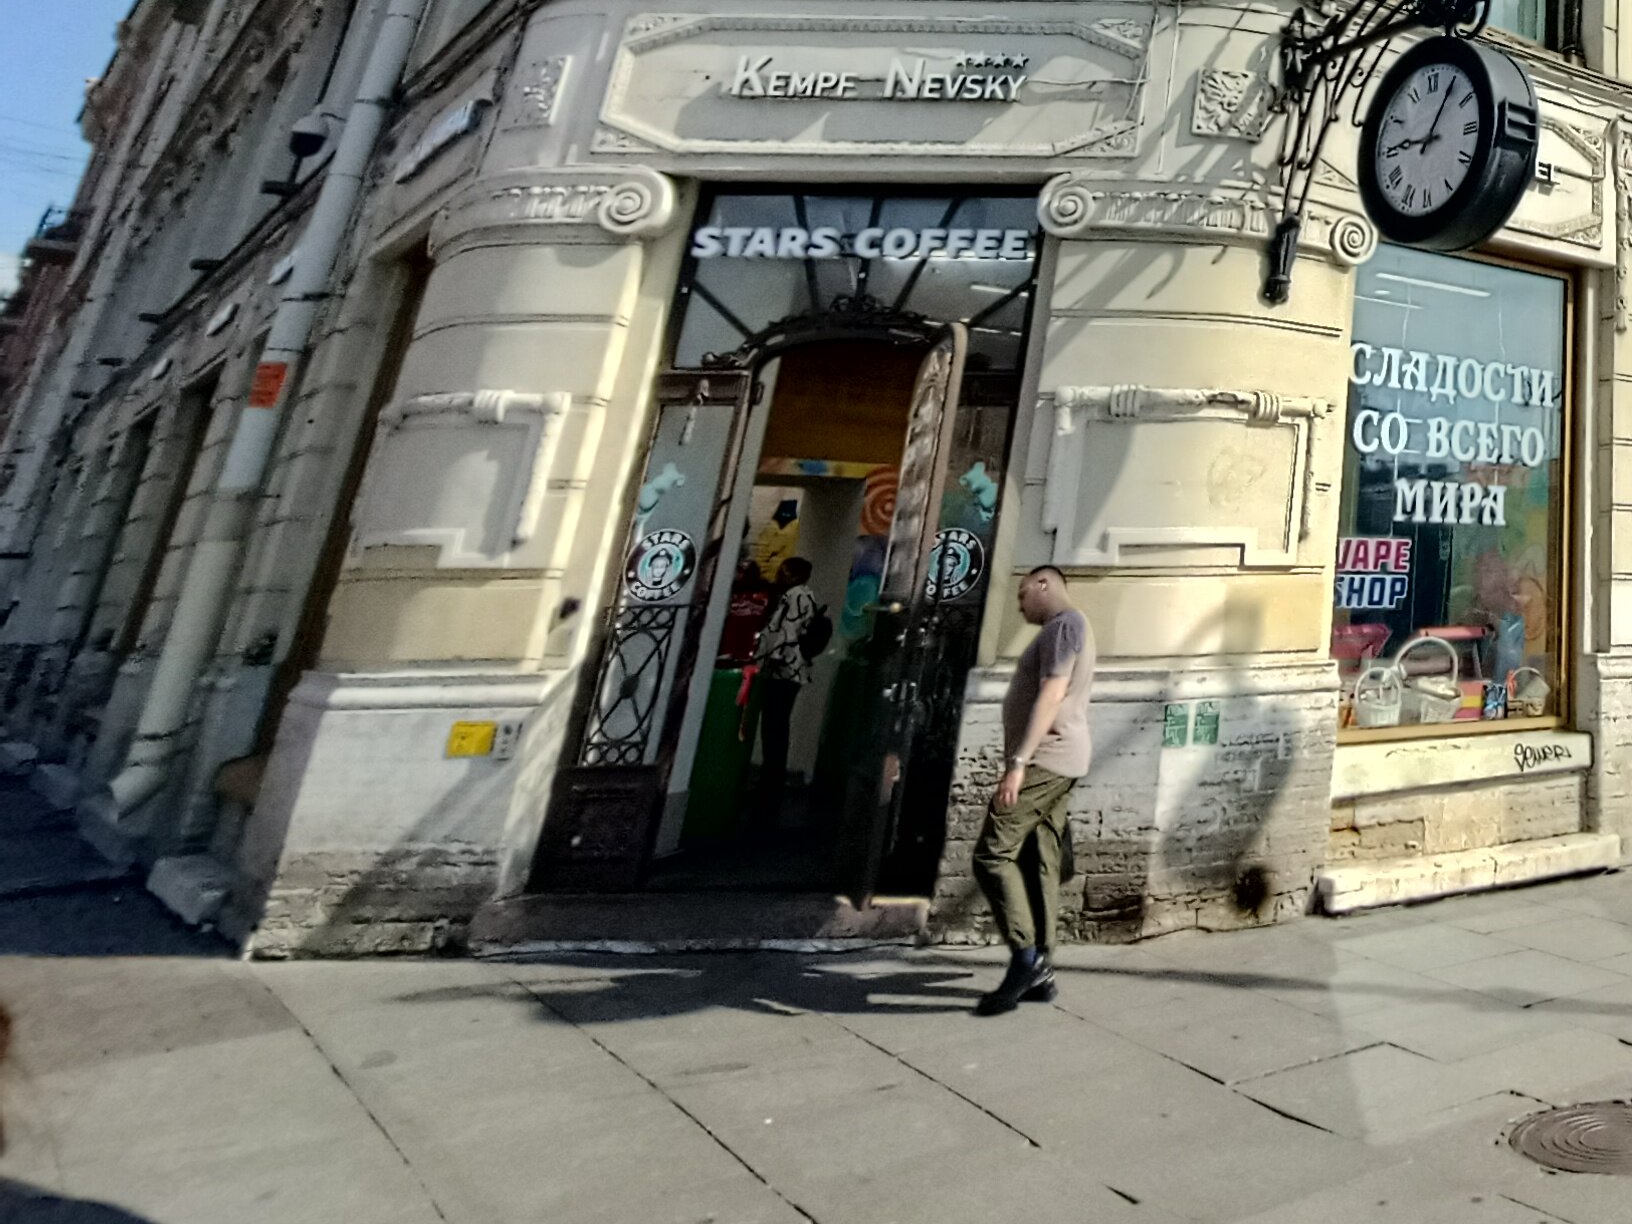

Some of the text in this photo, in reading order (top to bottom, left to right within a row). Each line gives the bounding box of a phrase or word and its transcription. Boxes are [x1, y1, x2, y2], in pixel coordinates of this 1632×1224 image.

[882, 57, 1028, 101] NEVSKY
[691, 227, 1030, 259] STARS COFFEE
[1350, 342, 1554, 407] СЛАДОСТИ
[1353, 409, 1545, 467] СО ВСЕГО
[1393, 478, 1507, 526] МИРА
[641, 532, 691, 551] STARS
[1336, 537, 1412, 573] VAPE
[630, 581, 681, 600] COFFEE
